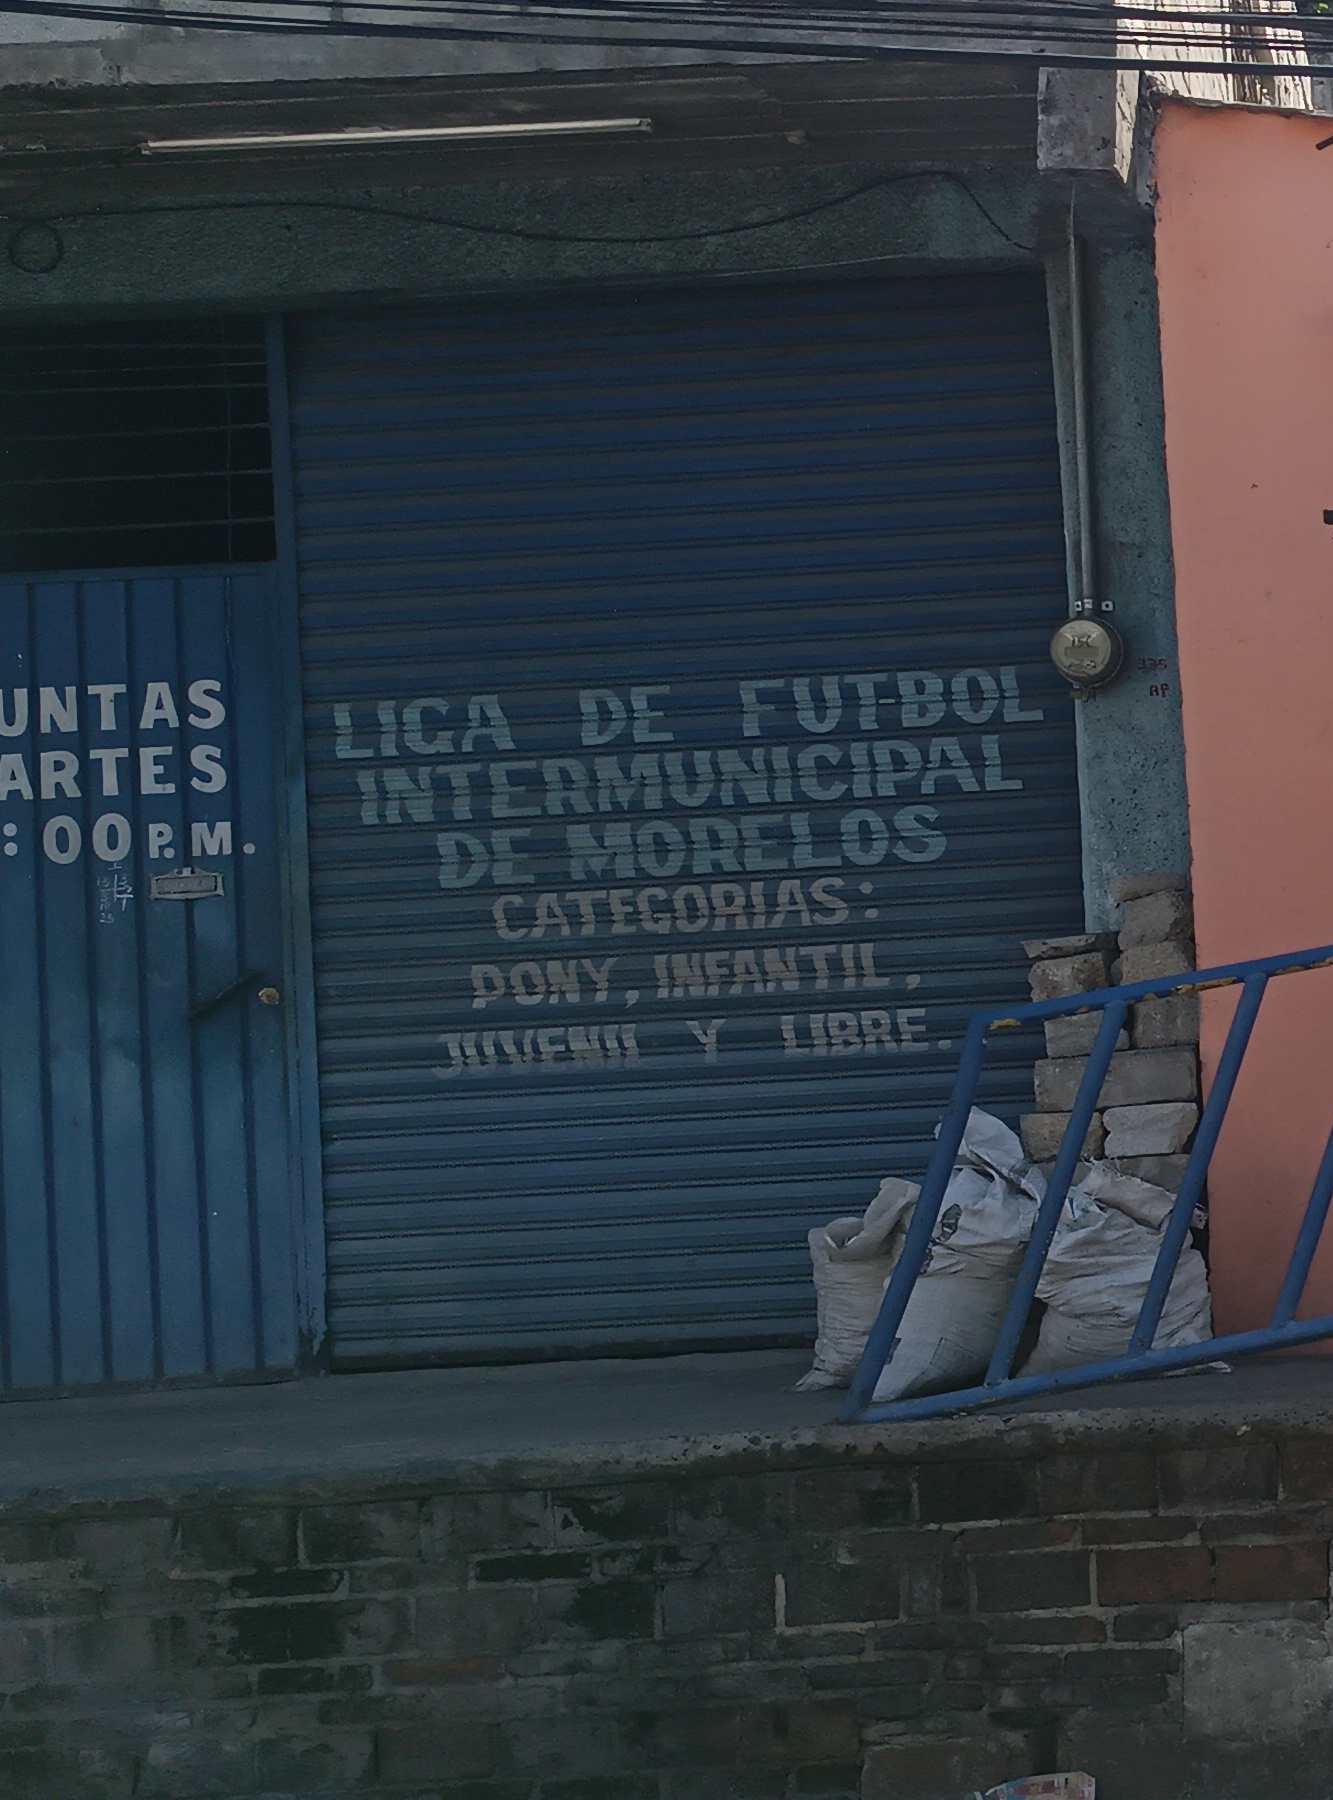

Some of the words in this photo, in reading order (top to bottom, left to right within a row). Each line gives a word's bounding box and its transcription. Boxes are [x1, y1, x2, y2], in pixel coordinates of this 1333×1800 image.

[333, 693, 517, 759] LIGA
[578, 684, 675, 747] DE
[356, 734, 1025, 826] INTERMUNICIPAL
[436, 826, 537, 889] DE
[566, 803, 949, 882] MORELOS
[493, 875, 879, 941] CATEGORIAS:
[684, 1018, 728, 1063] Y
